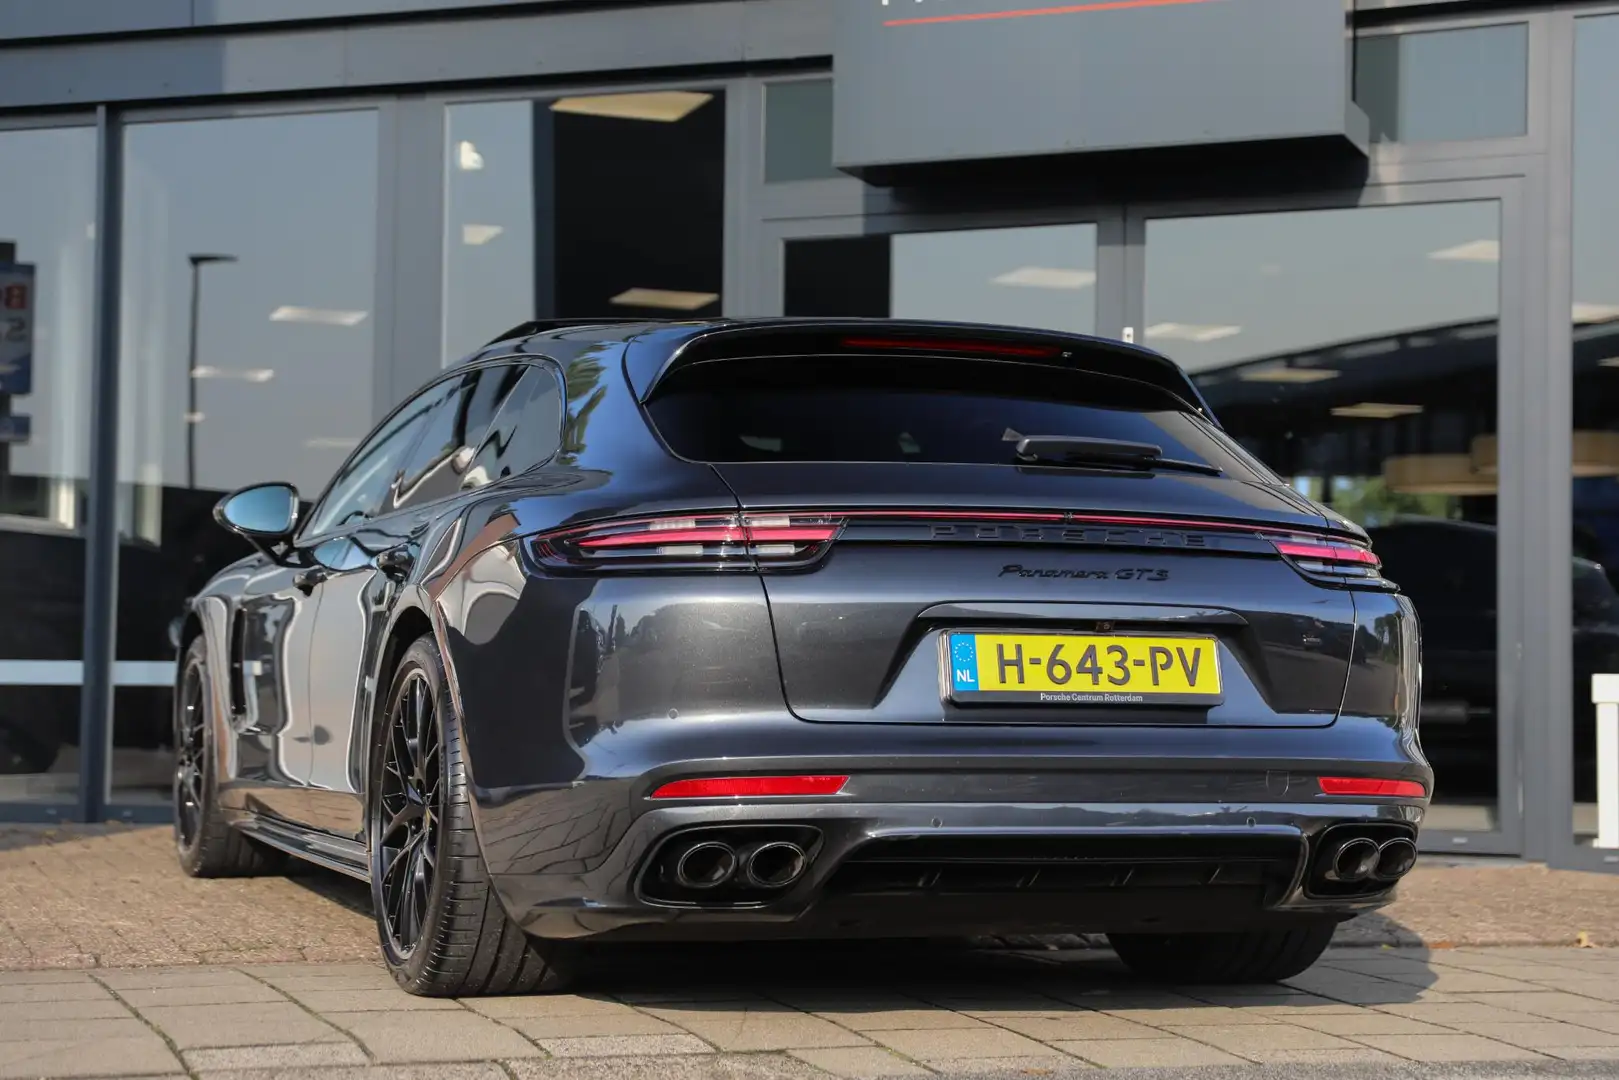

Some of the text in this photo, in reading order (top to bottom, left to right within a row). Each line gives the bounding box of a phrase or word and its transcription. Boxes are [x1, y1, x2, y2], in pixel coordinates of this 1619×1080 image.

[931, 524, 1206, 547] PORSCHE
[998, 563, 1171, 582] Panamera GTS
[995, 643, 1202, 687] H-643-PV
[956, 669, 975, 683] NL
[1040, 692, 1143, 703] Porsche Centrum Rotterdam
